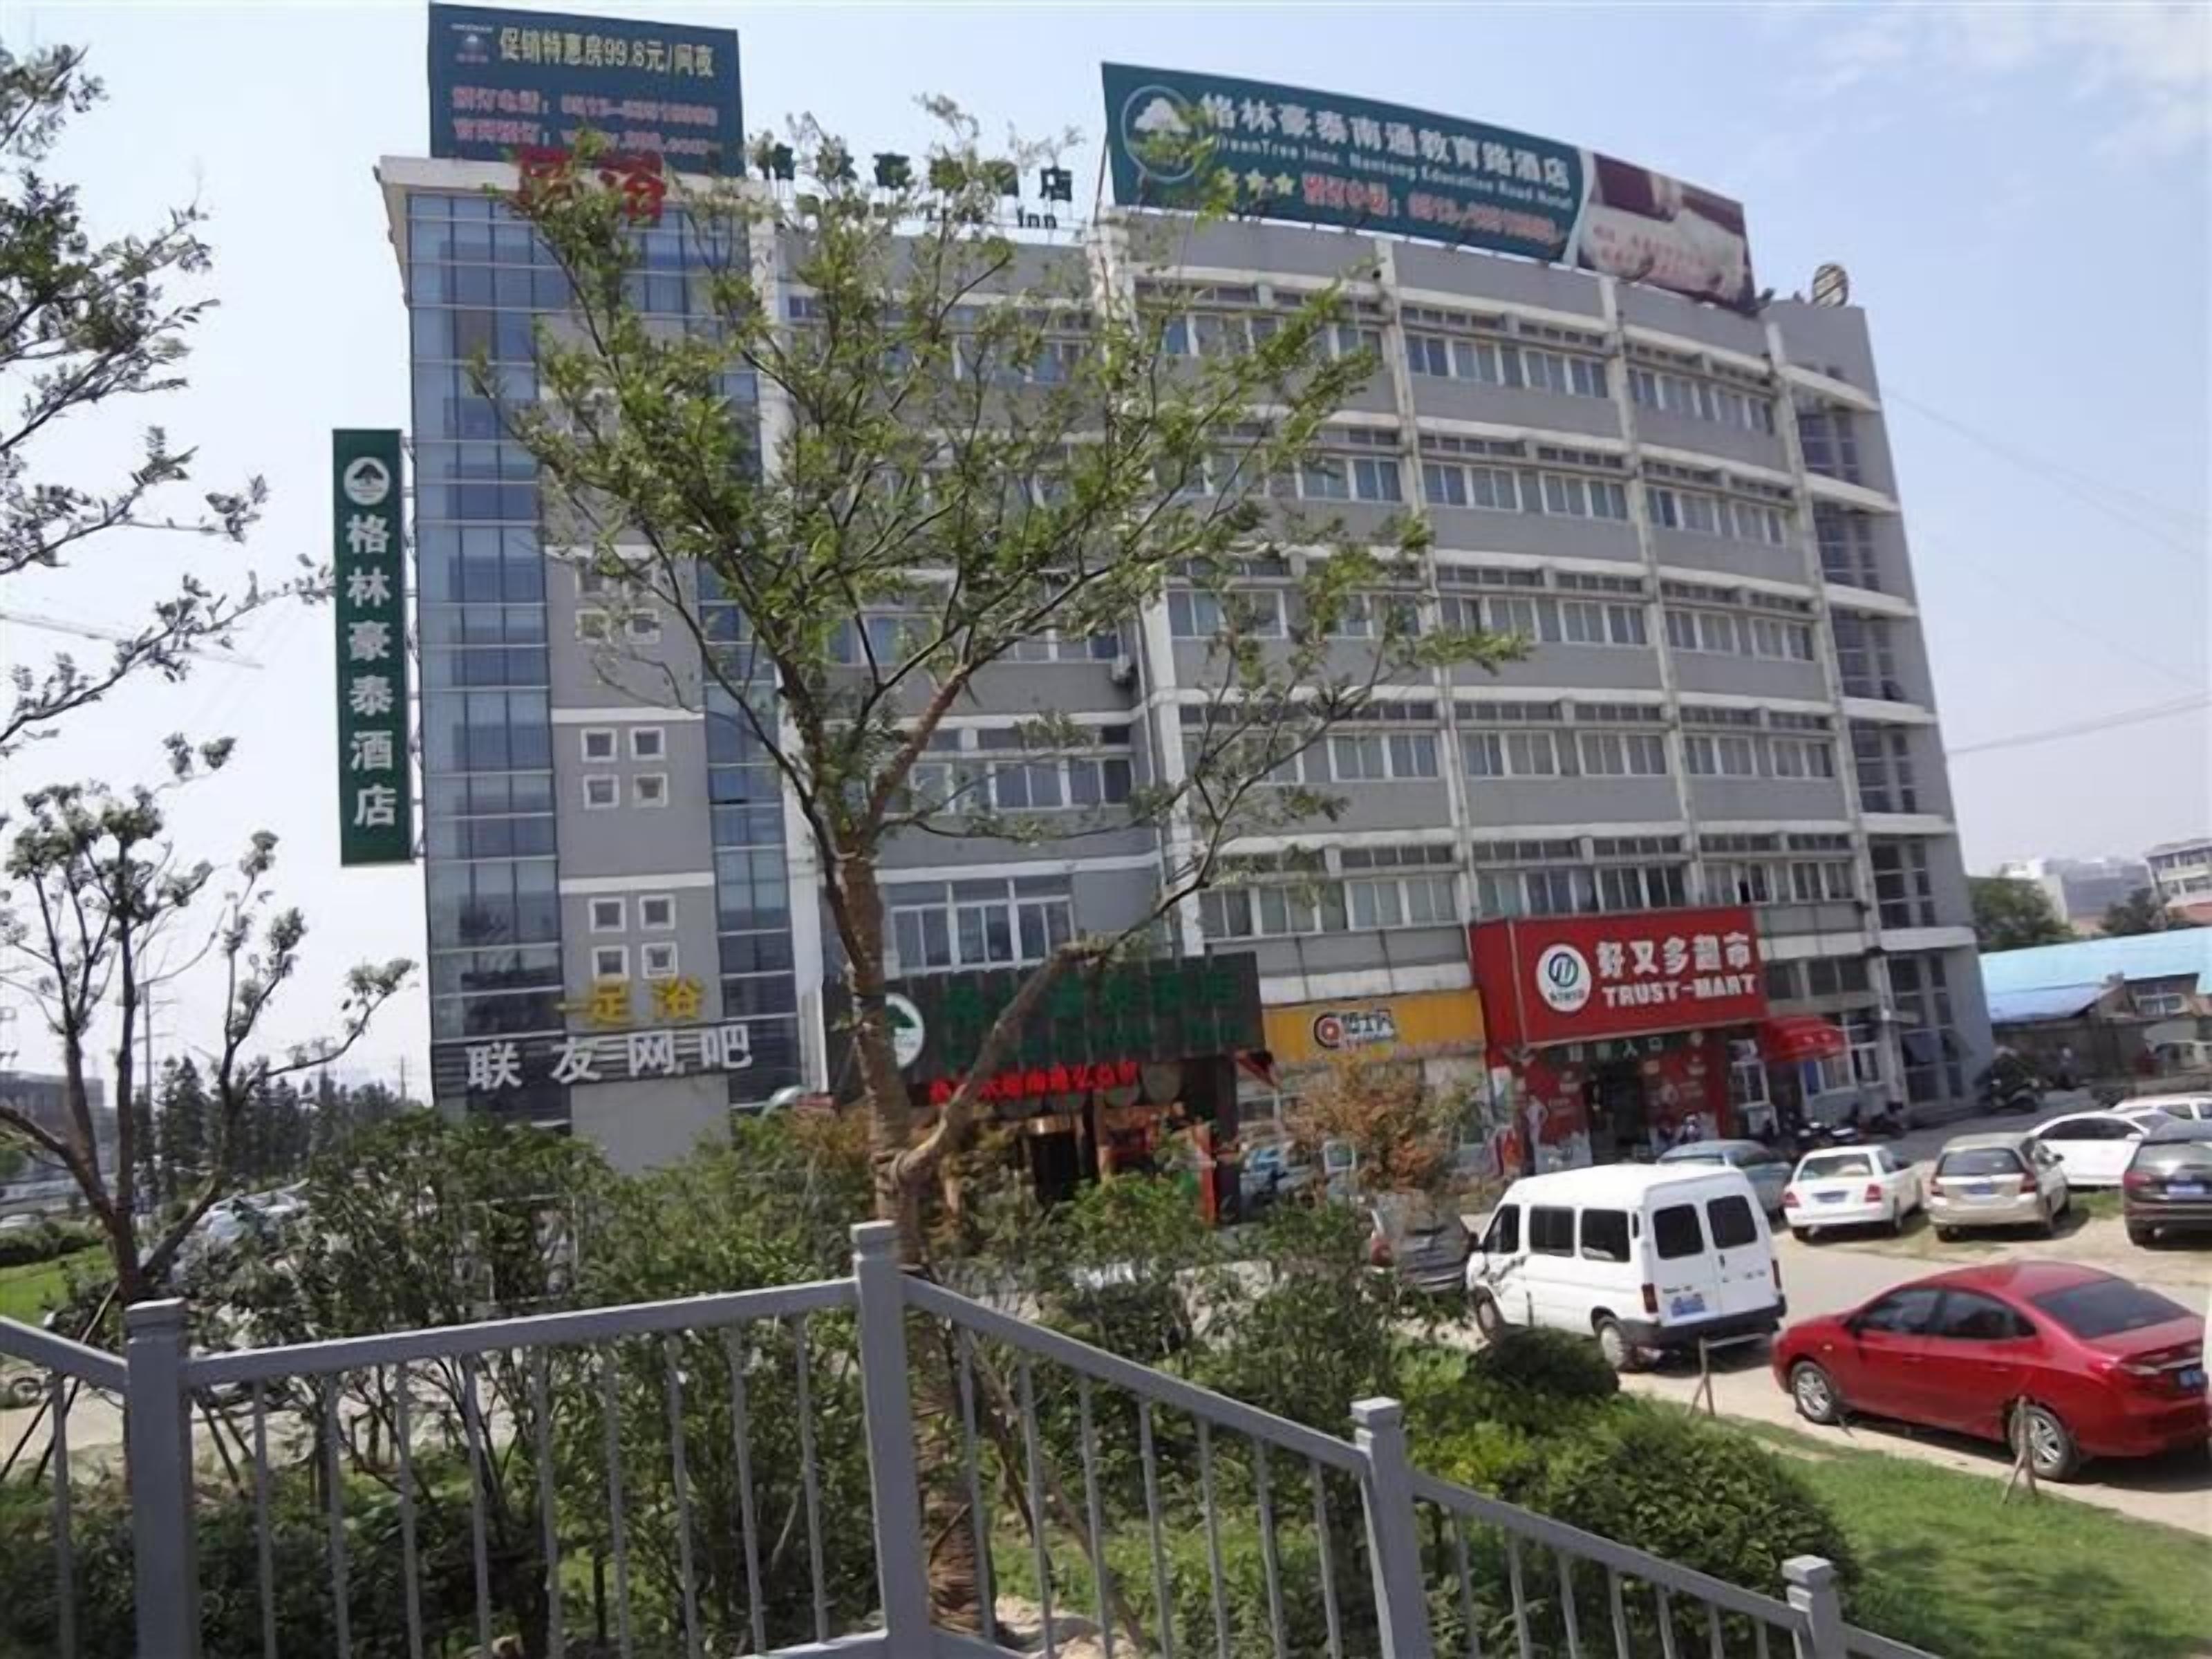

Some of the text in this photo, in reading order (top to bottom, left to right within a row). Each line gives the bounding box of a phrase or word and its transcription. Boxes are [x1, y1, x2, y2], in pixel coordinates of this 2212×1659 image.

[346, 513, 397, 827] 格林豪泰酒店
[1596, 931, 1750, 979] 好又多超市
[1601, 973, 1756, 1008] TRUST-MART
[465, 1024, 753, 1090] 联友网吧
